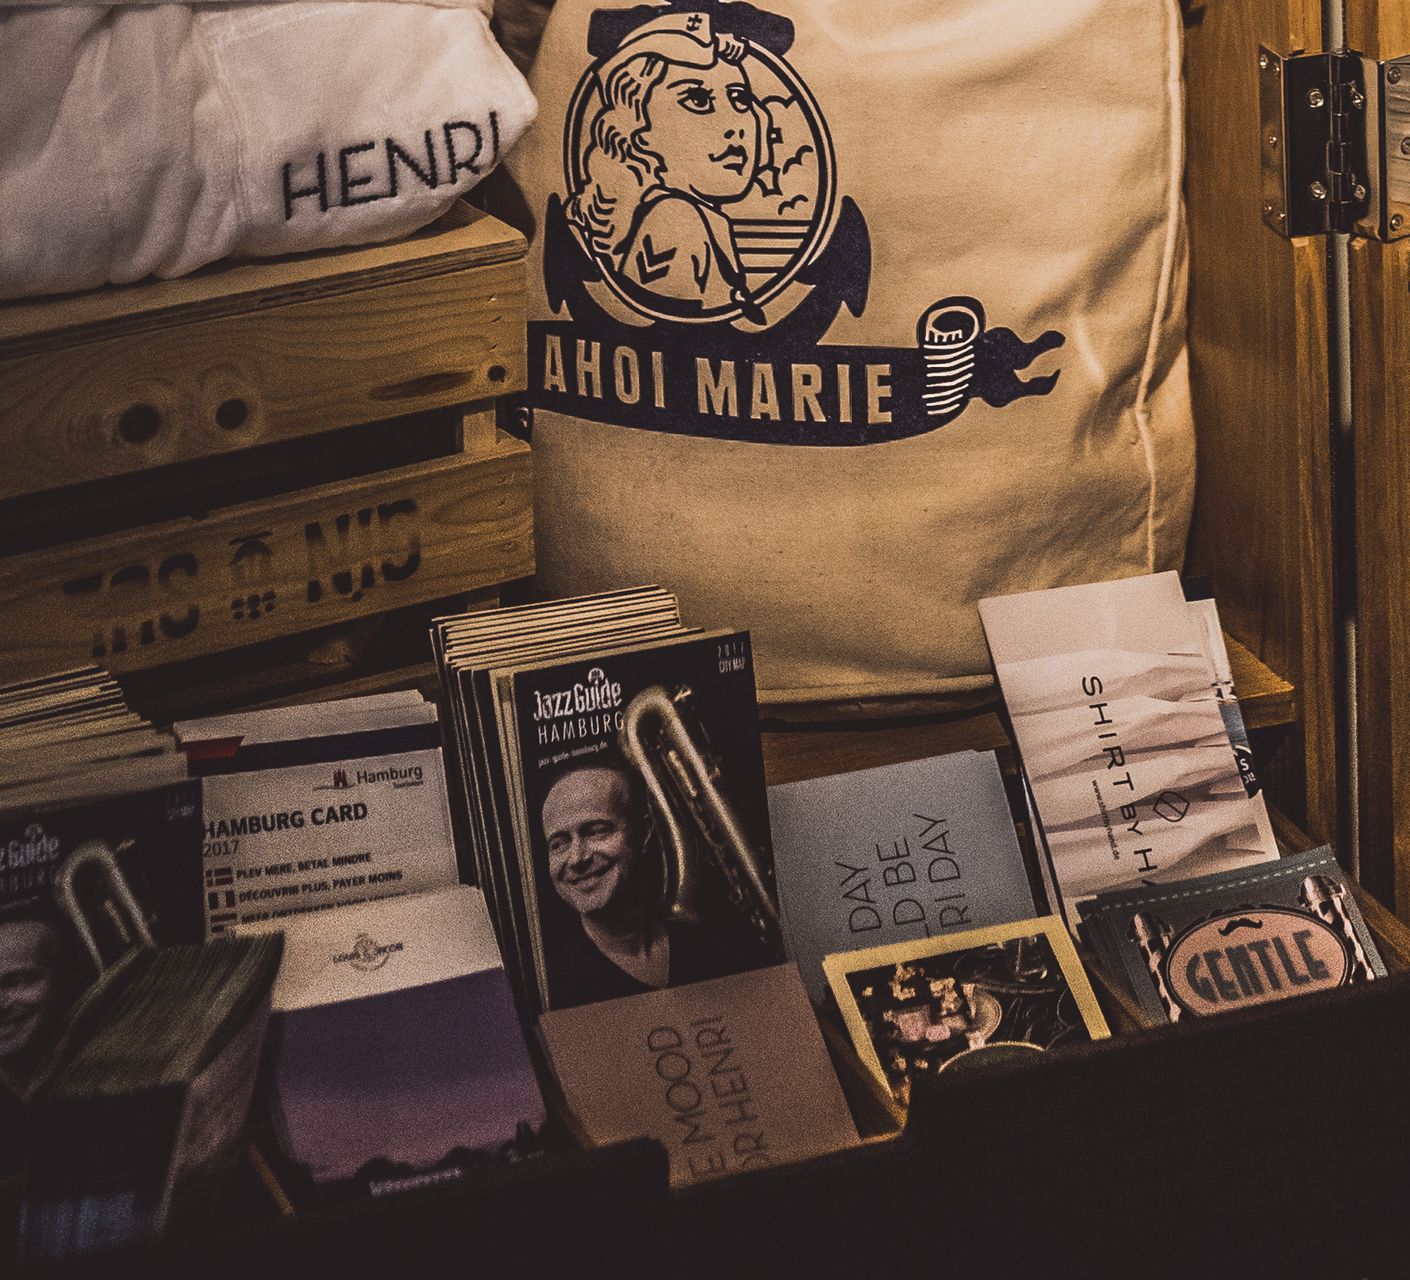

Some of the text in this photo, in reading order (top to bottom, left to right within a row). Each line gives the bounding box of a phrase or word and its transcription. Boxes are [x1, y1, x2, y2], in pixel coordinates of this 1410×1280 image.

[282, 110, 499, 221] HENRI
[543, 333, 894, 425] AHOI MARIE
[537, 710, 624, 746] HAMBURG
[1081, 675, 1143, 837] SHIRT BY
[356, 765, 423, 786] Hamburg
[202, 802, 368, 839] HAMBURG CARD
[203, 840, 240, 858] 2017
[912, 812, 961, 884] DAY
[836, 860, 882, 934] DAY
[876, 835, 917, 888] BE
[1185, 930, 1331, 1004] GENTLE
[647, 1025, 708, 1147] MOOD
[690, 1015, 760, 1130] HENRI
